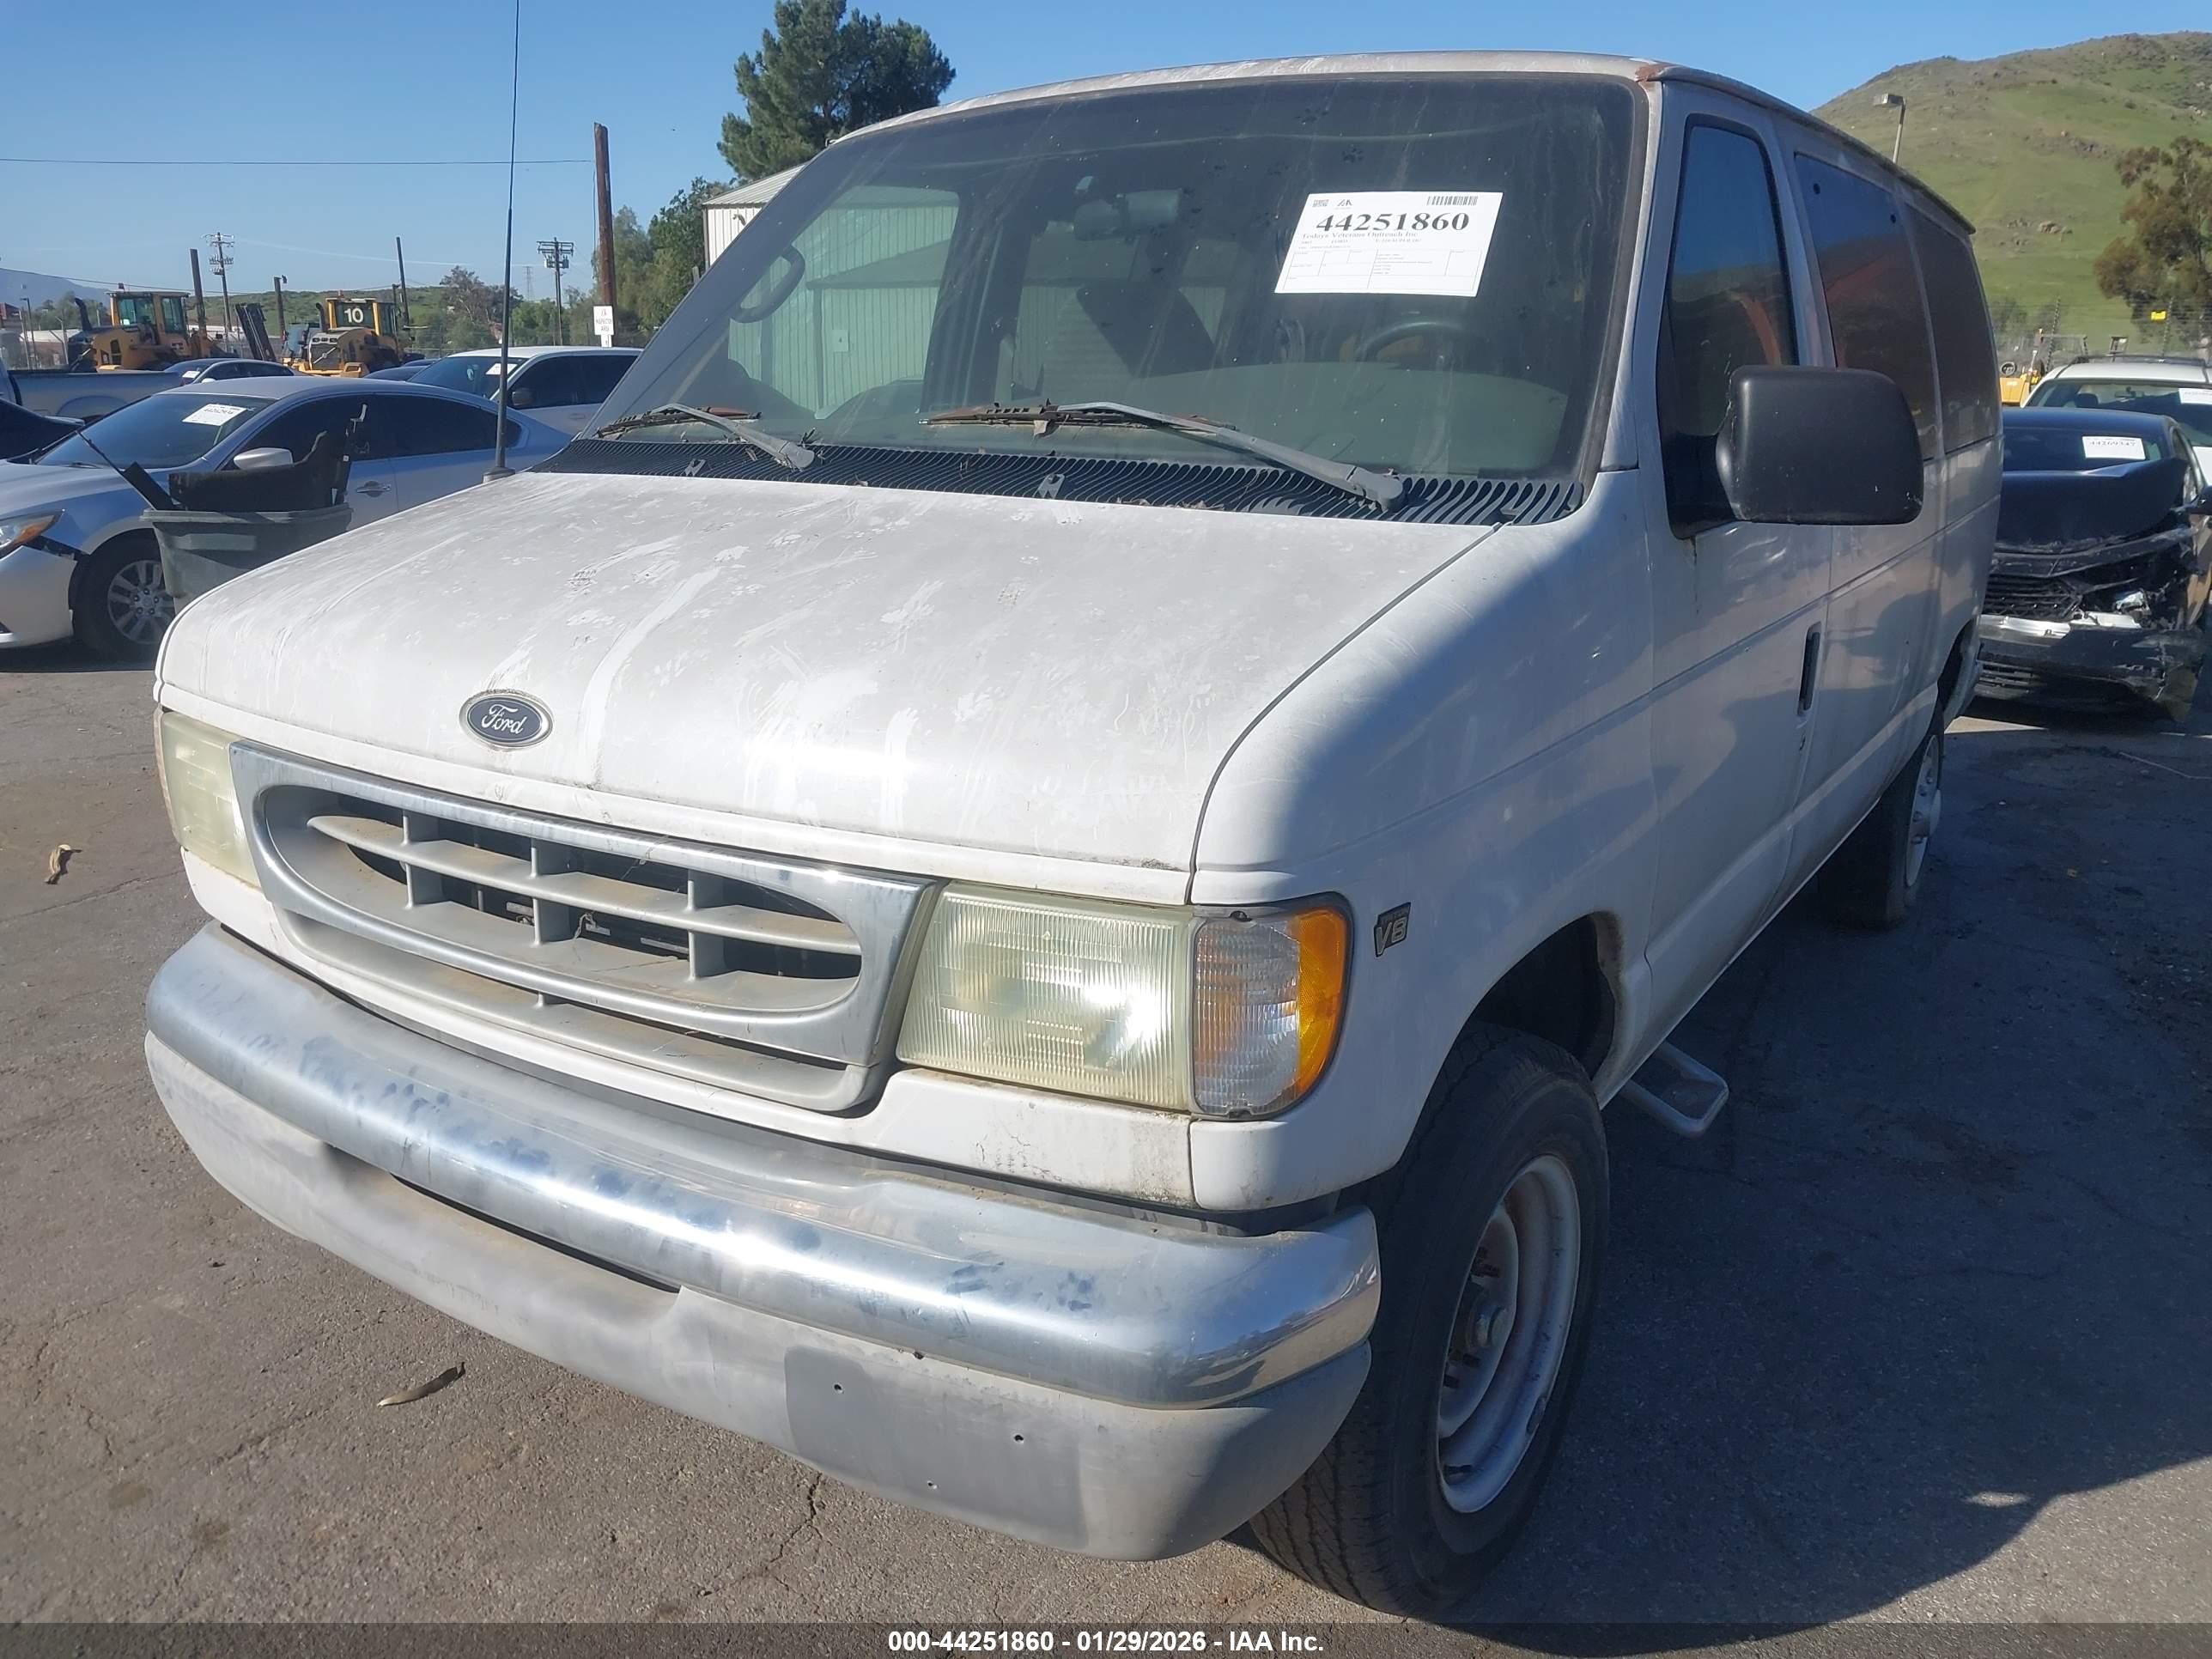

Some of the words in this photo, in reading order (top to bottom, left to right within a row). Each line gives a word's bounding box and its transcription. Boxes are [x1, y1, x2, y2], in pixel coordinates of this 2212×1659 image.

[1315, 212, 1469, 232] 44251860
[343, 307, 364, 324] 10
[481, 703, 527, 734] Ford
[1375, 916, 1407, 955] V8
